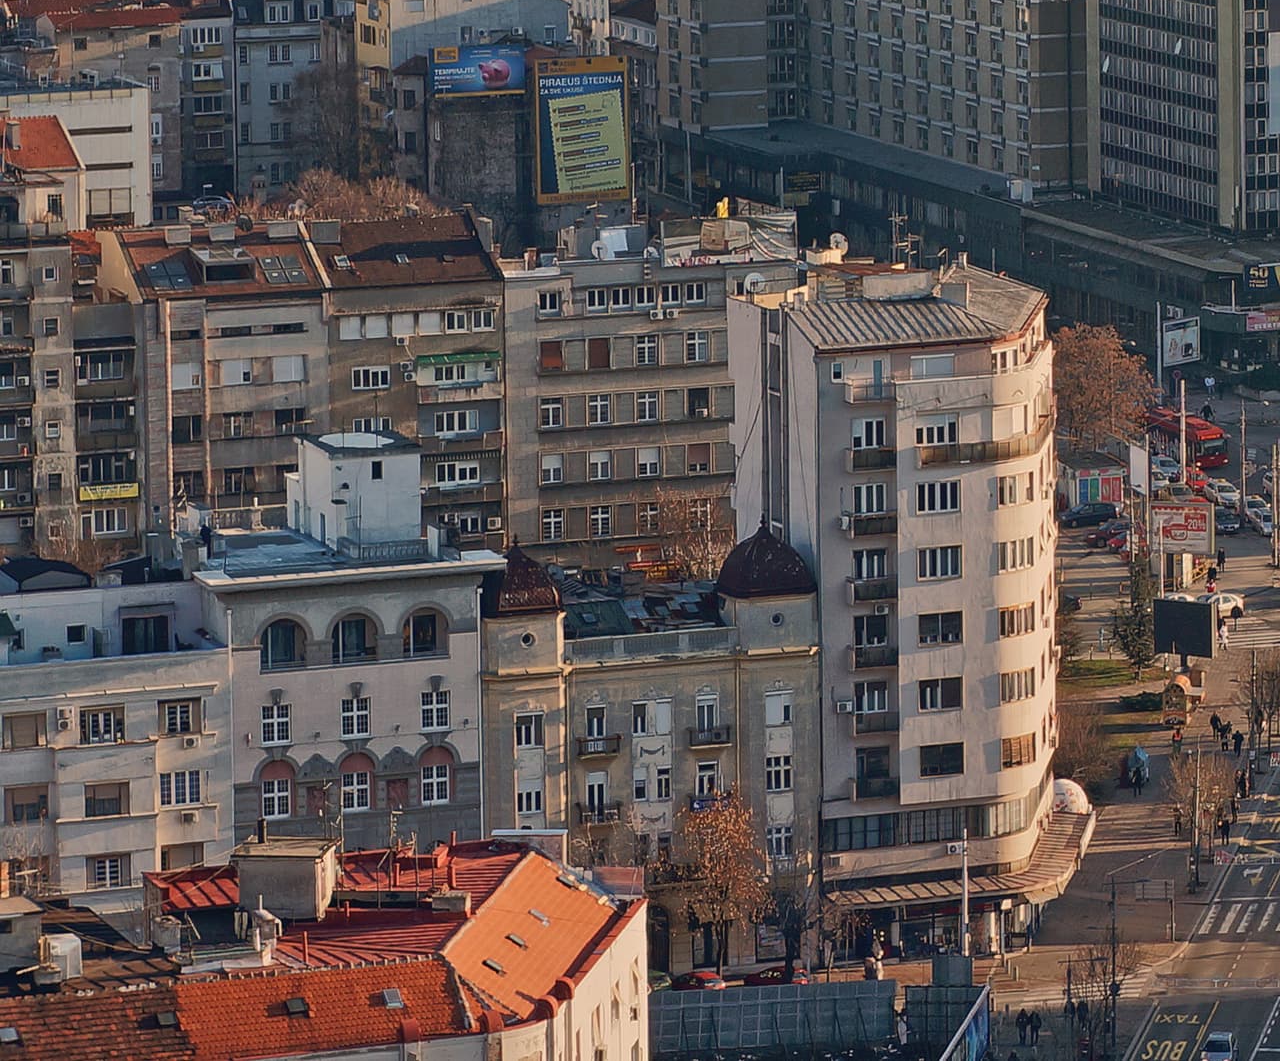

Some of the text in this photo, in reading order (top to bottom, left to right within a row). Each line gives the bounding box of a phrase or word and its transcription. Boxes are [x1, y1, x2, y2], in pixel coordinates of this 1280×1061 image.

[539, 74, 624, 88] PIRAEUS ŠTEDNJA
[1248, 266, 1269, 279] 50
[1154, 1014, 1200, 1024] TAXI
[1141, 1039, 1188, 1060] BUS
